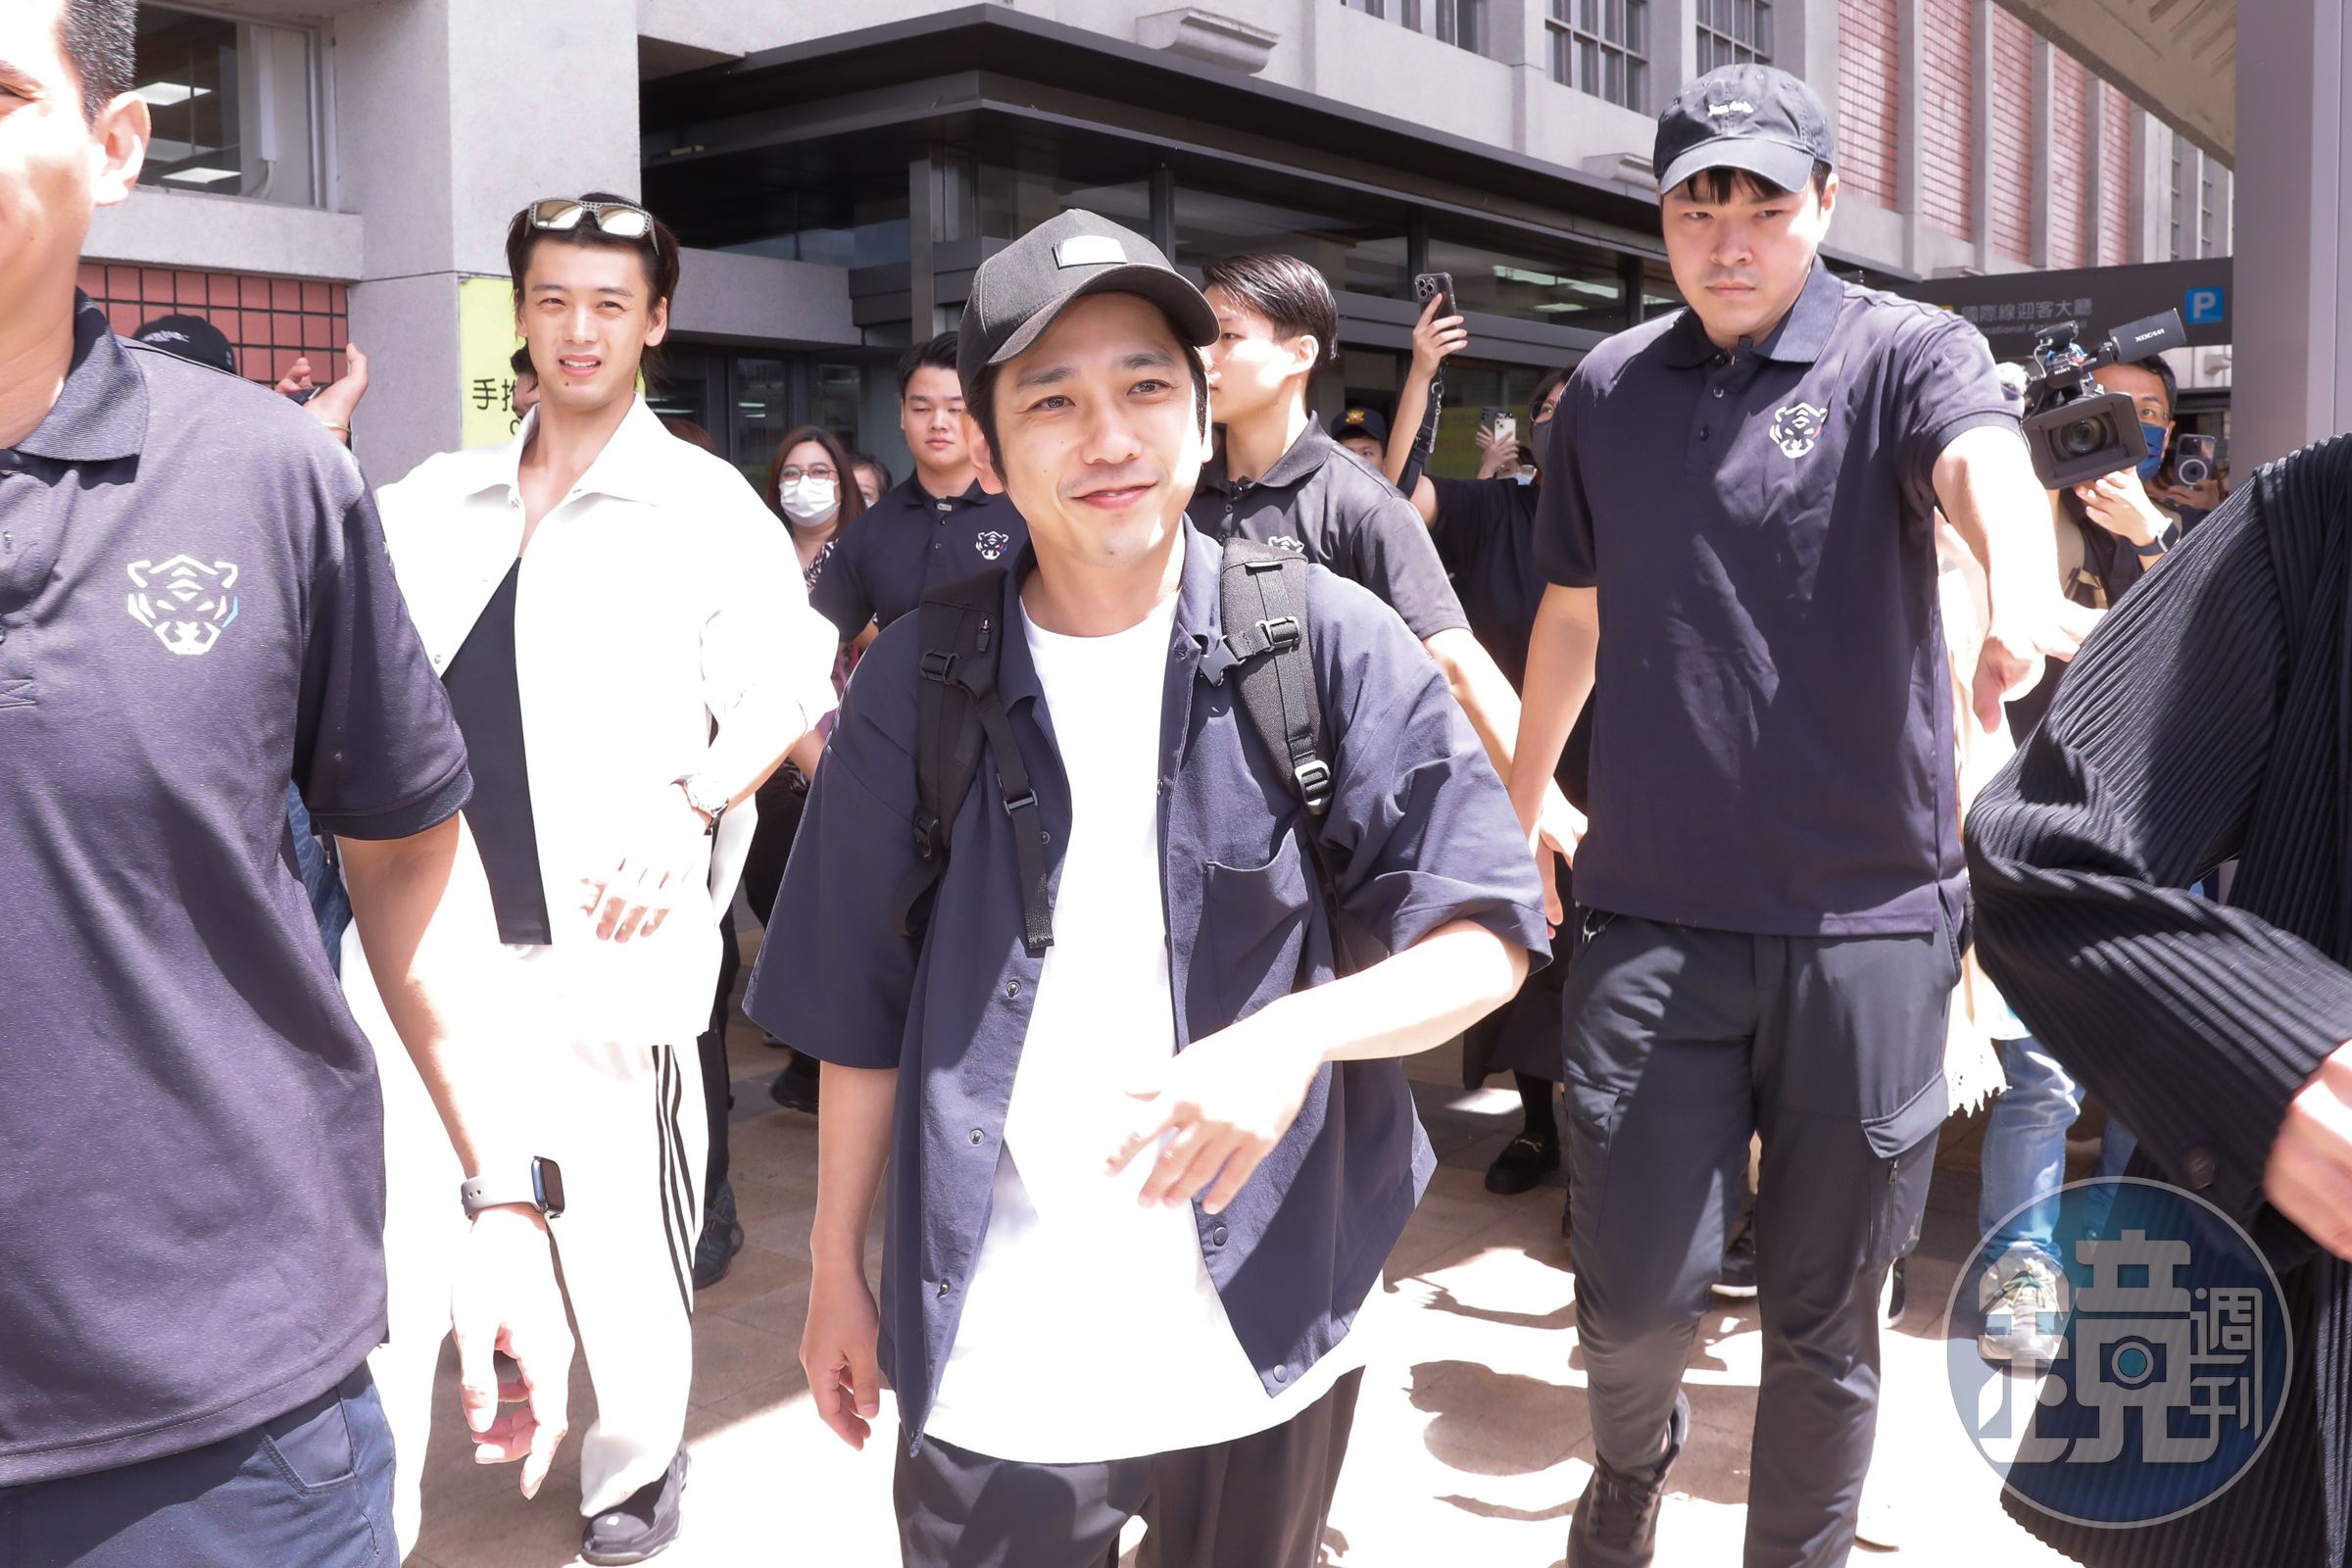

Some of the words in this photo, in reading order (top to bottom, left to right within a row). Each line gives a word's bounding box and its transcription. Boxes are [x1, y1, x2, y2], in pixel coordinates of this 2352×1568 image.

[1961, 298, 2092, 323] 國際線迎客大廳
[2193, 292, 2216, 318] P
[2053, 366, 2071, 375] SONY
